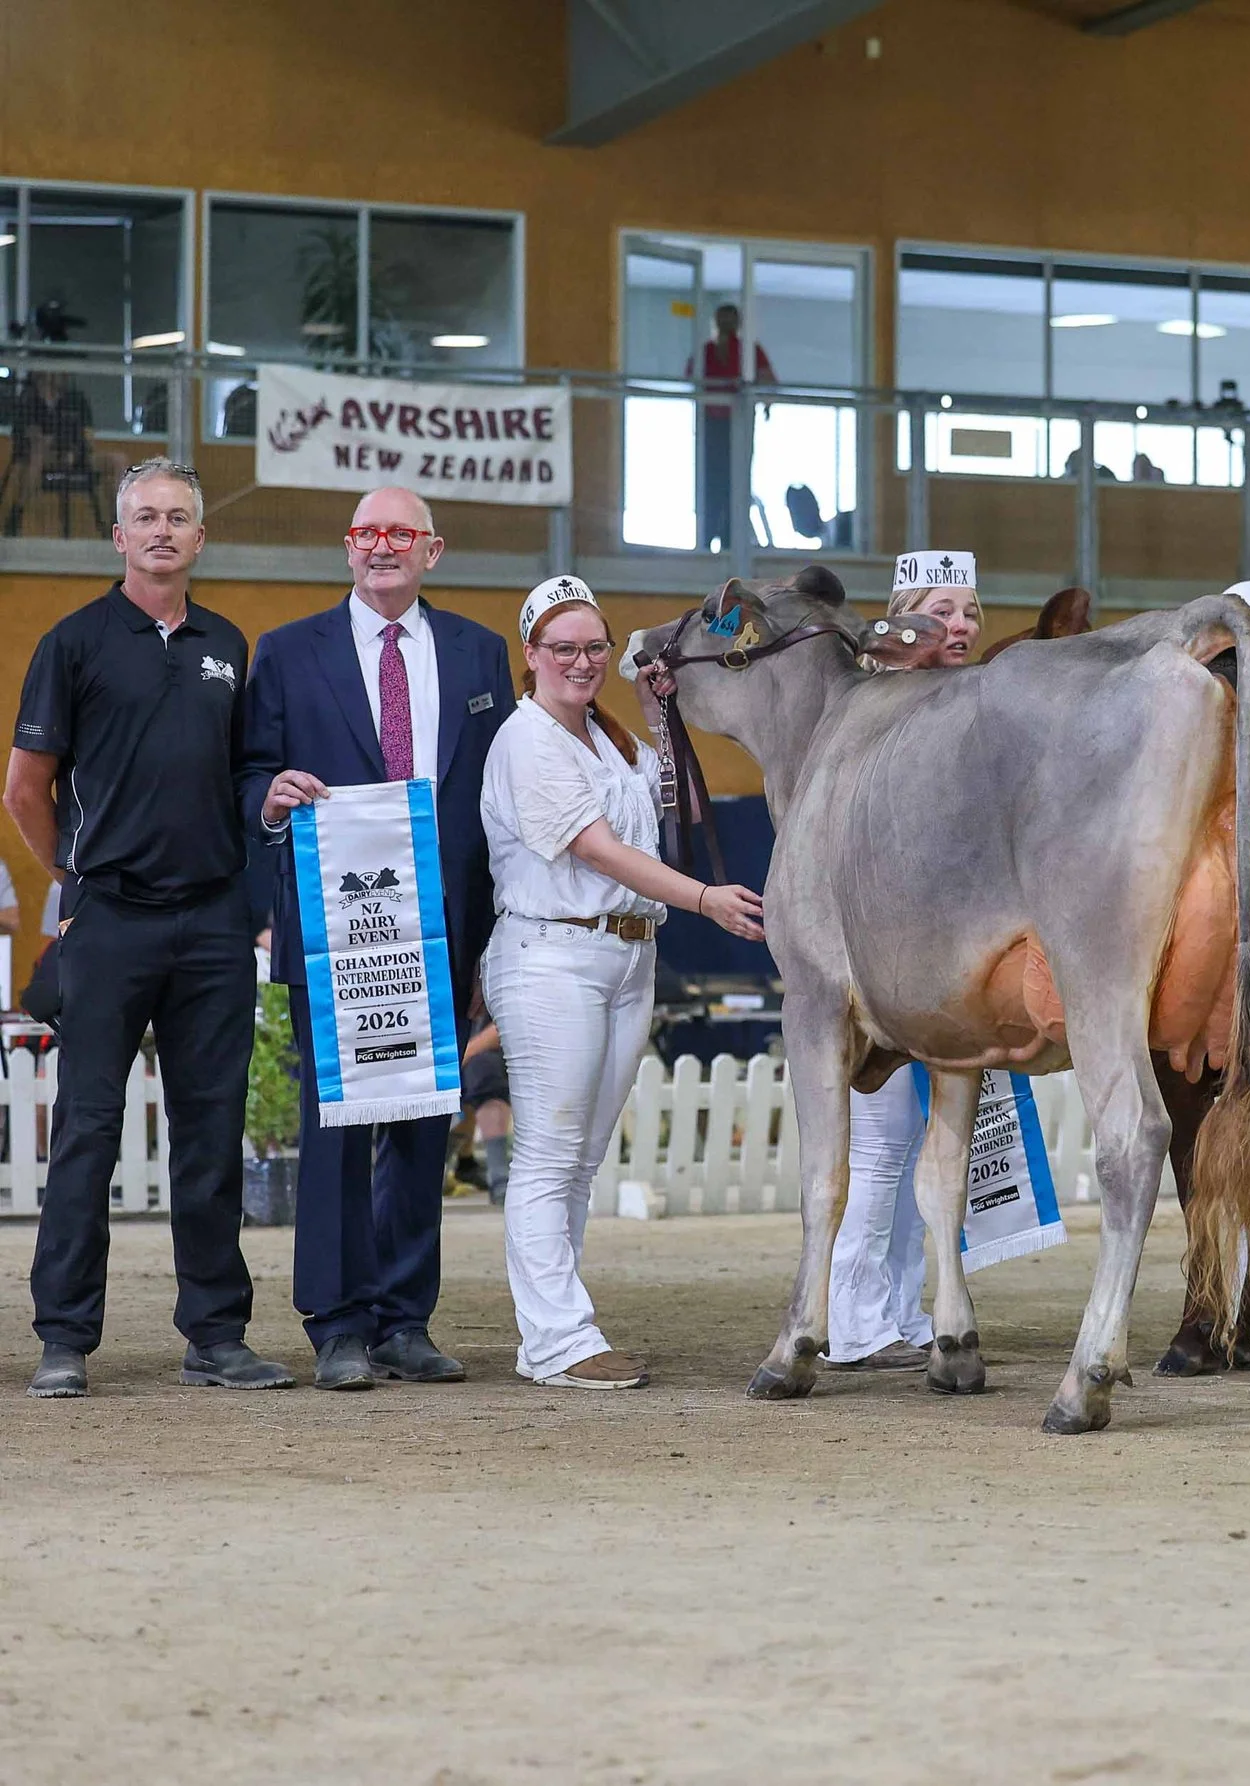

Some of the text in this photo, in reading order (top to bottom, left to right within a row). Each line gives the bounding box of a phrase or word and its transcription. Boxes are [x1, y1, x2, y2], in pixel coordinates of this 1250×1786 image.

[340, 398, 553, 443] AYRSHIRE
[334, 445, 553, 483] NEW ZEALAND
[926, 568, 968, 585] SEMEX
[364, 874, 374, 882] NZ
[348, 889, 394, 901] DAIRYEVENT
[361, 902, 383, 916] NZ
[349, 914, 397, 931] DAIRY
[348, 928, 401, 945] EVENT
[335, 951, 420, 971] CHAMPION
[337, 966, 422, 986] INTERMEDIATE
[338, 981, 422, 1001] COMBINED
[356, 1009, 409, 1032] 2026
[357, 1048, 416, 1062] PGG Wrightson
[976, 1102, 1003, 1118] ERVE
[974, 1110, 1012, 1131] MPION
[970, 1120, 1018, 1145] RMEDIATE
[971, 1156, 1010, 1185] 2026
[985, 1191, 1019, 1206] Wrightson
